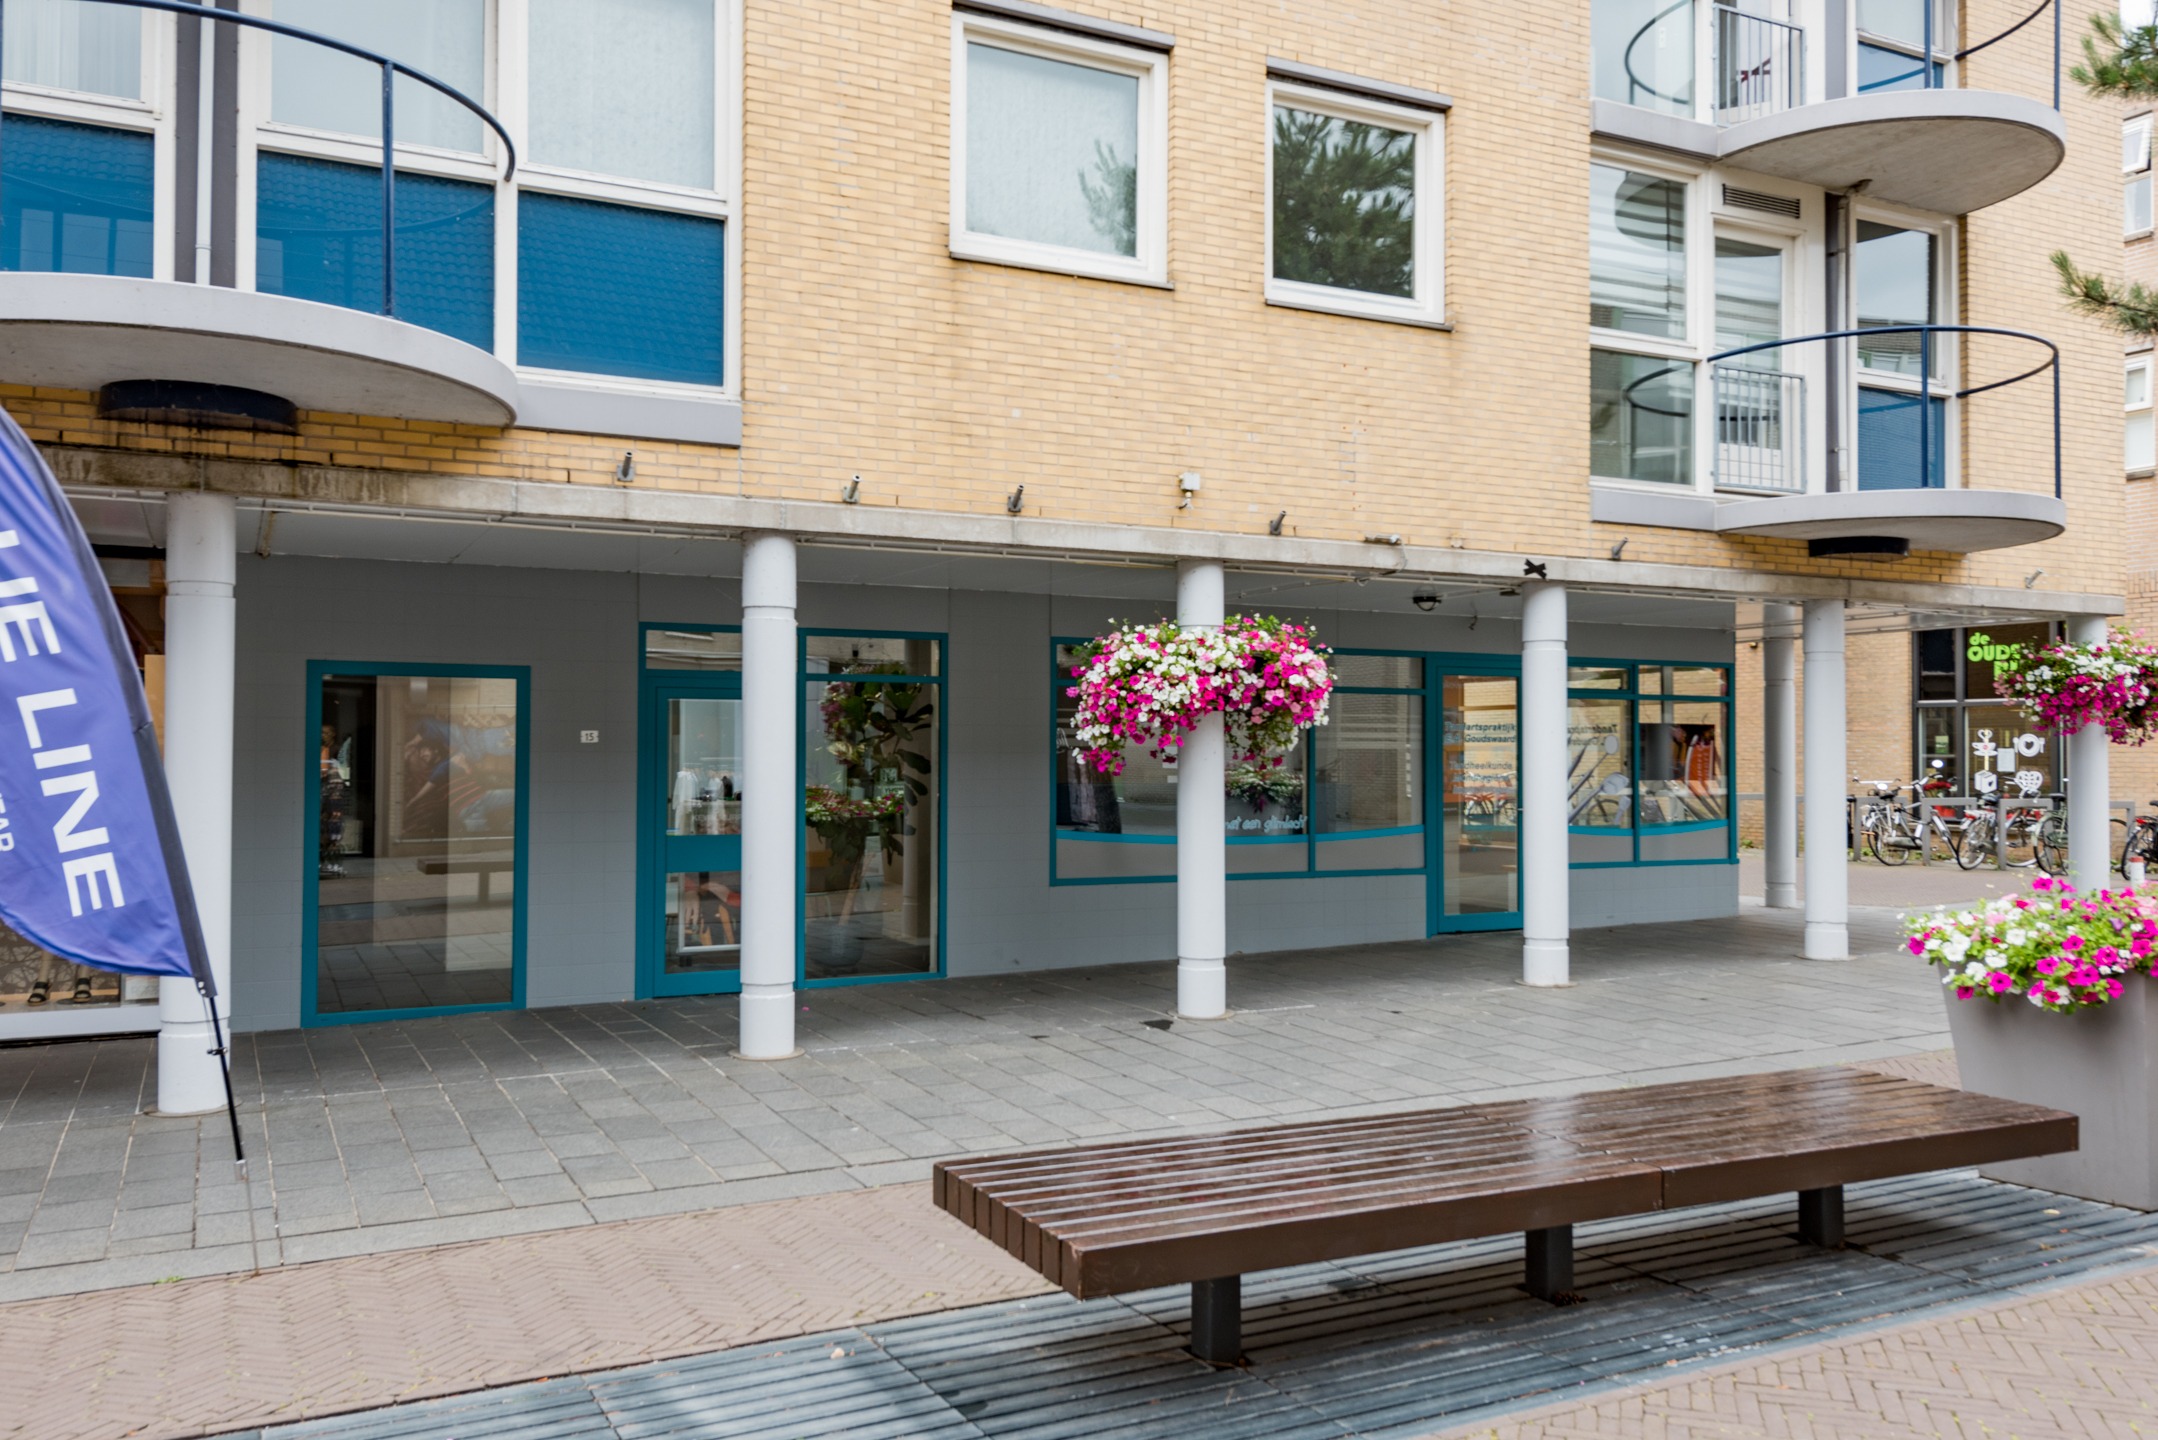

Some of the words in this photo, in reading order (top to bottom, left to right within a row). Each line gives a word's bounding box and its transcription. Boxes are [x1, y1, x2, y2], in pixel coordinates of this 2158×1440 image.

[1969, 632, 1990, 644] de
[585, 733, 595, 741] 15
[17, 688, 125, 917] LINE
